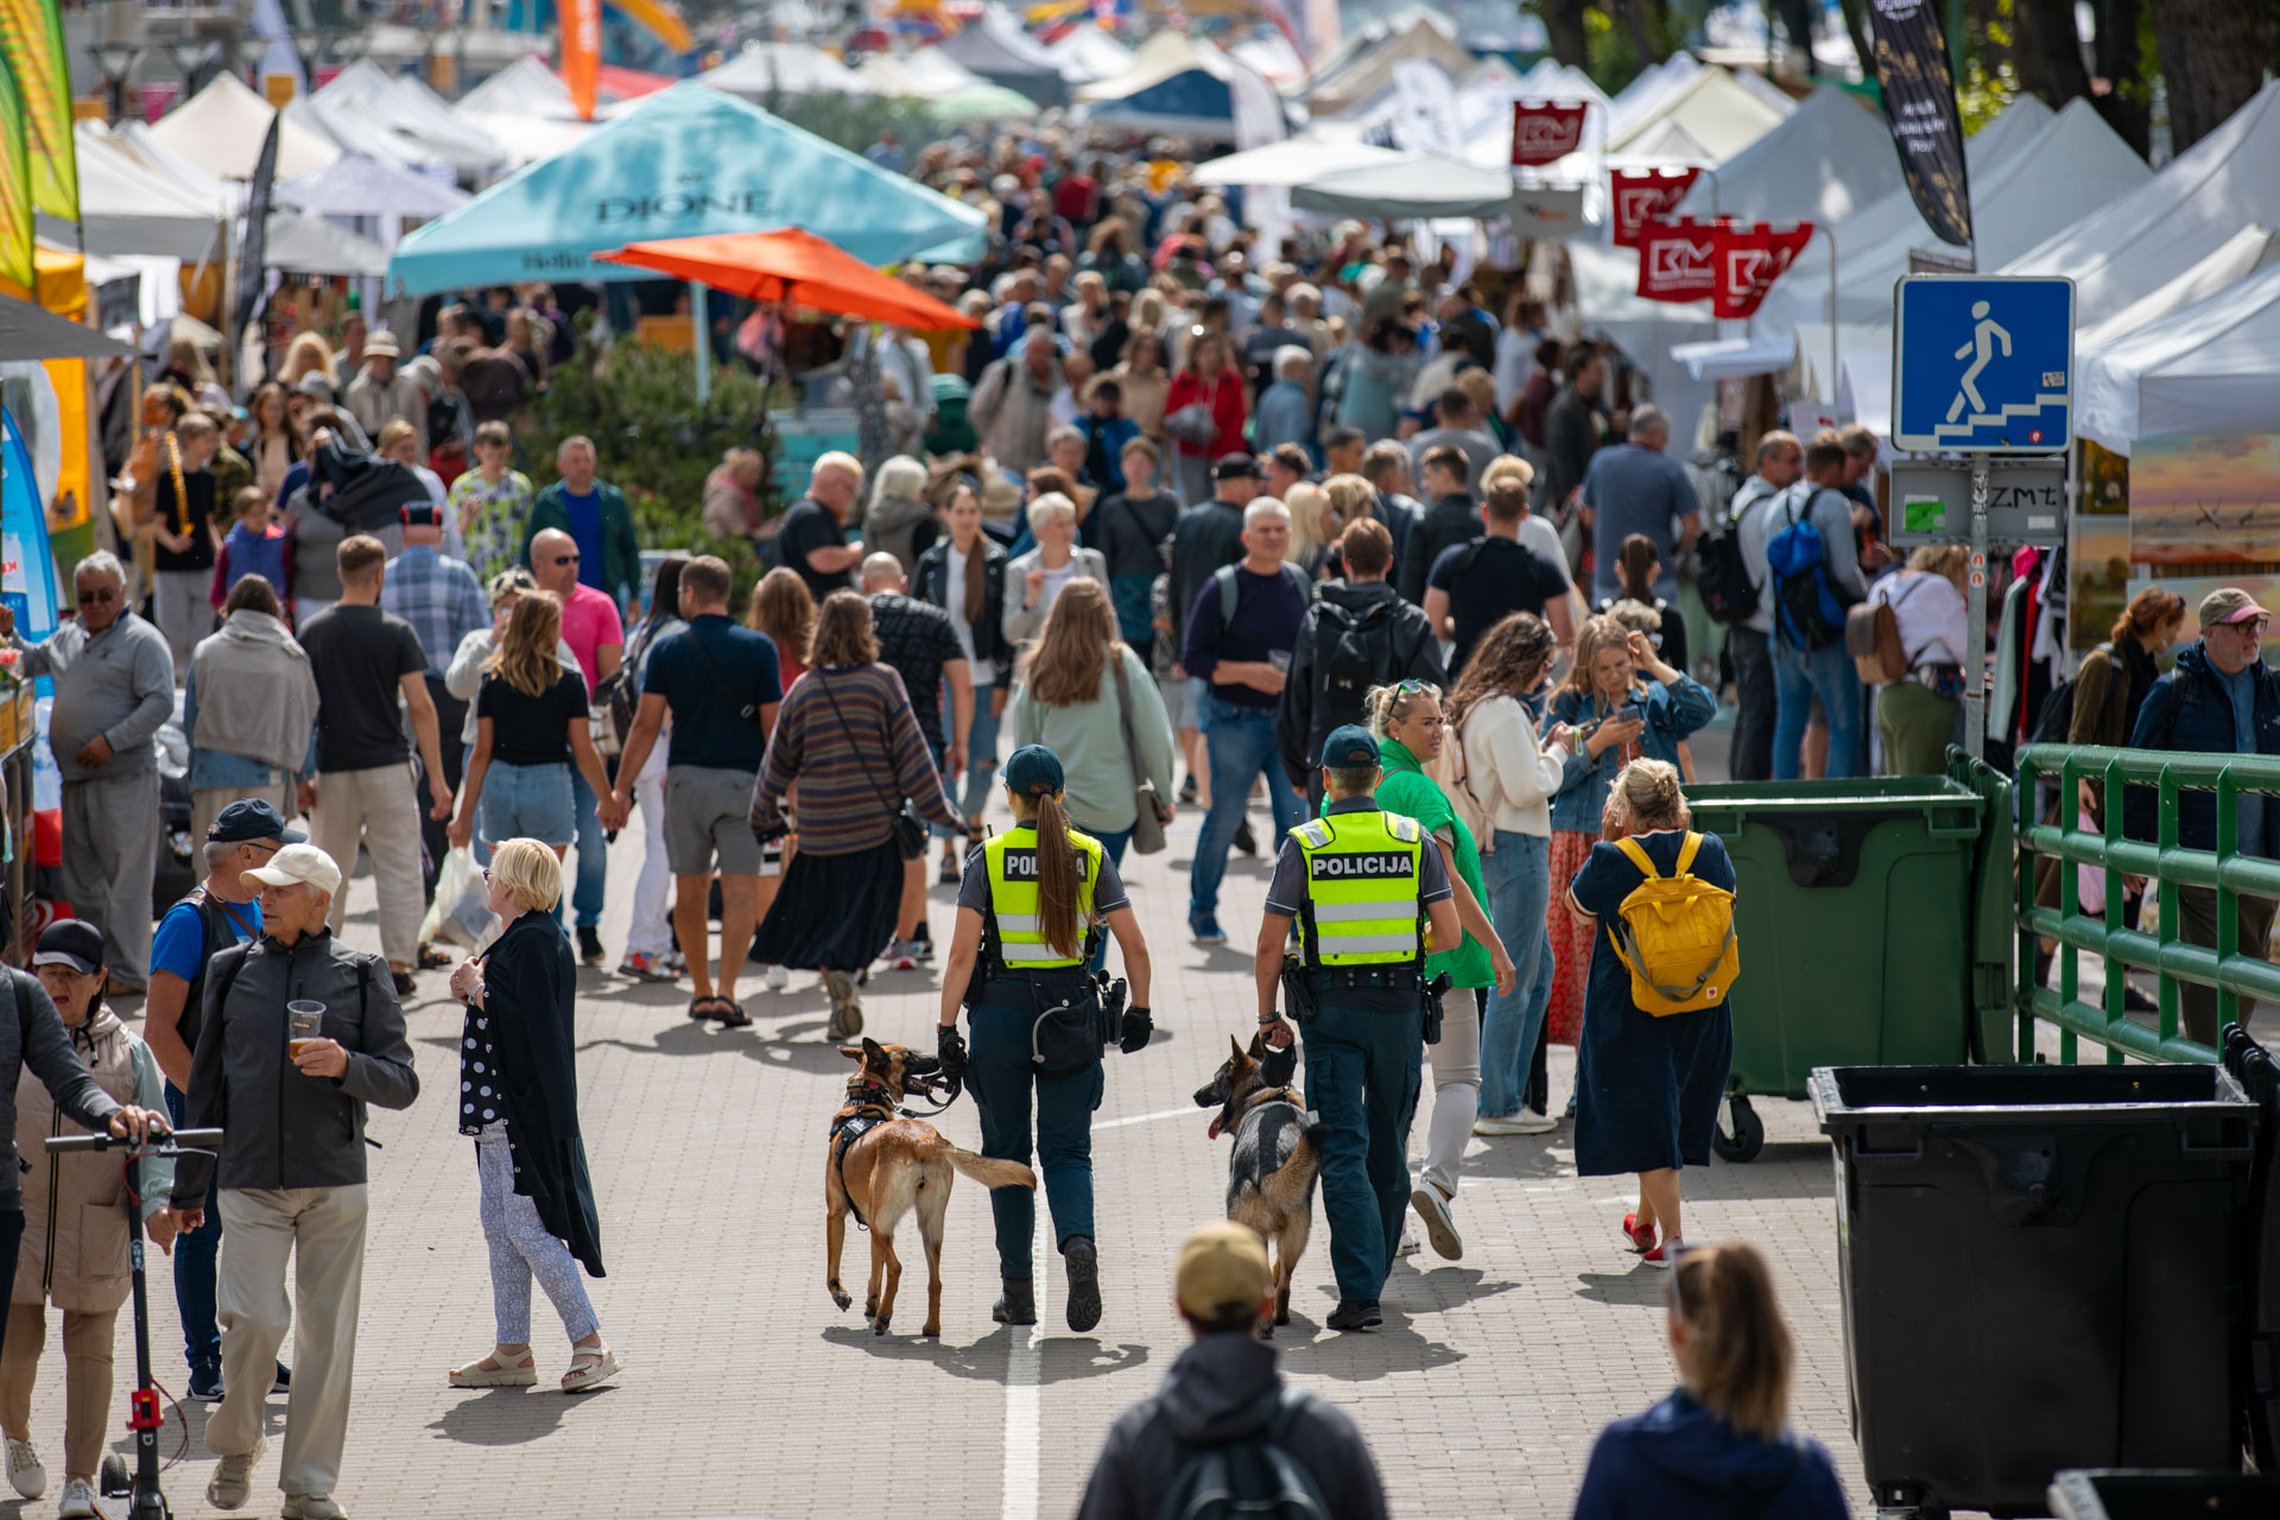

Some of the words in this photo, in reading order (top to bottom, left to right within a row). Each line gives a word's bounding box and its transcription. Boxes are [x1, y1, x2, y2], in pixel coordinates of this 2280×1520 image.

[597, 191, 774, 222] DIONE
[1007, 856, 1086, 876] POLA
[1312, 856, 1412, 875] POLICIJA
